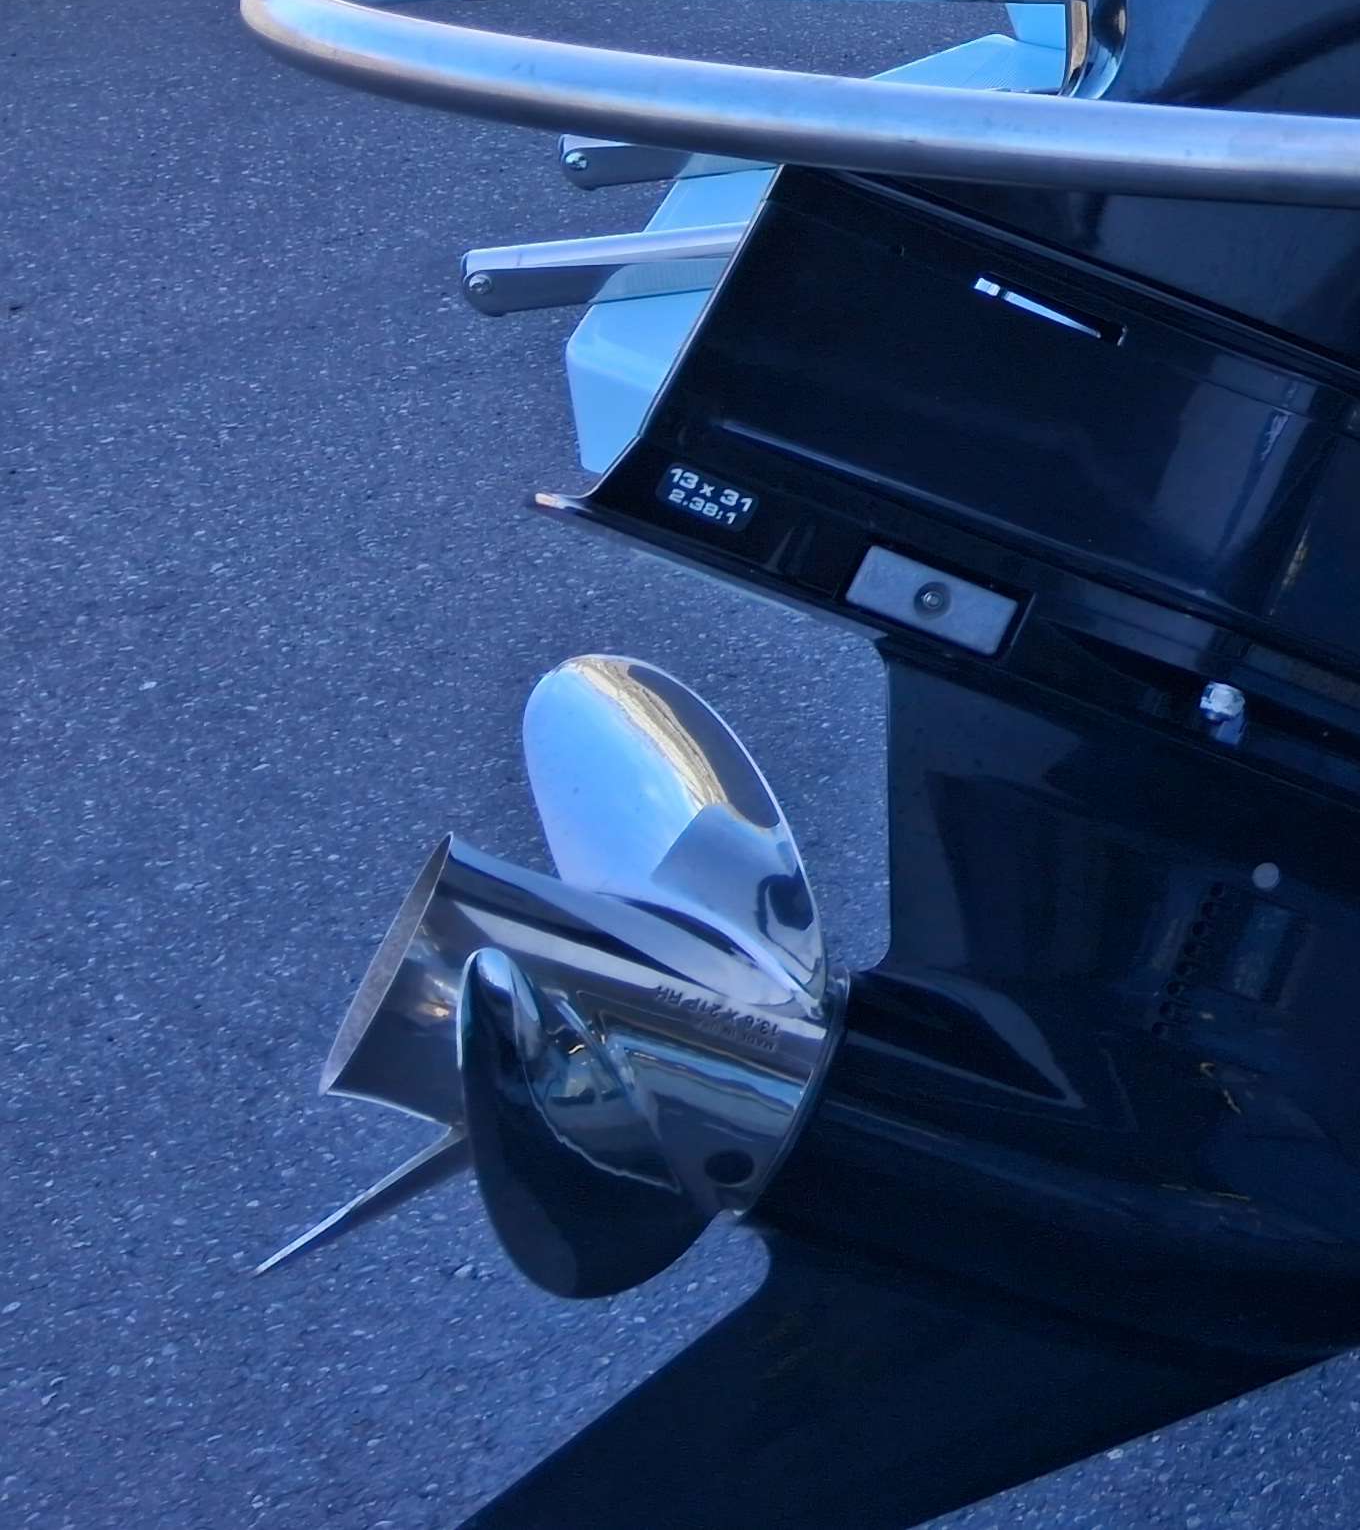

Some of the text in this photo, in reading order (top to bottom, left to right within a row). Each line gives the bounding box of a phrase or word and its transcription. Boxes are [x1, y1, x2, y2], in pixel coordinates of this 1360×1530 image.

[668, 489, 737, 524] 2.38:1
[671, 468, 699, 489] 13
[720, 489, 753, 512] 31
